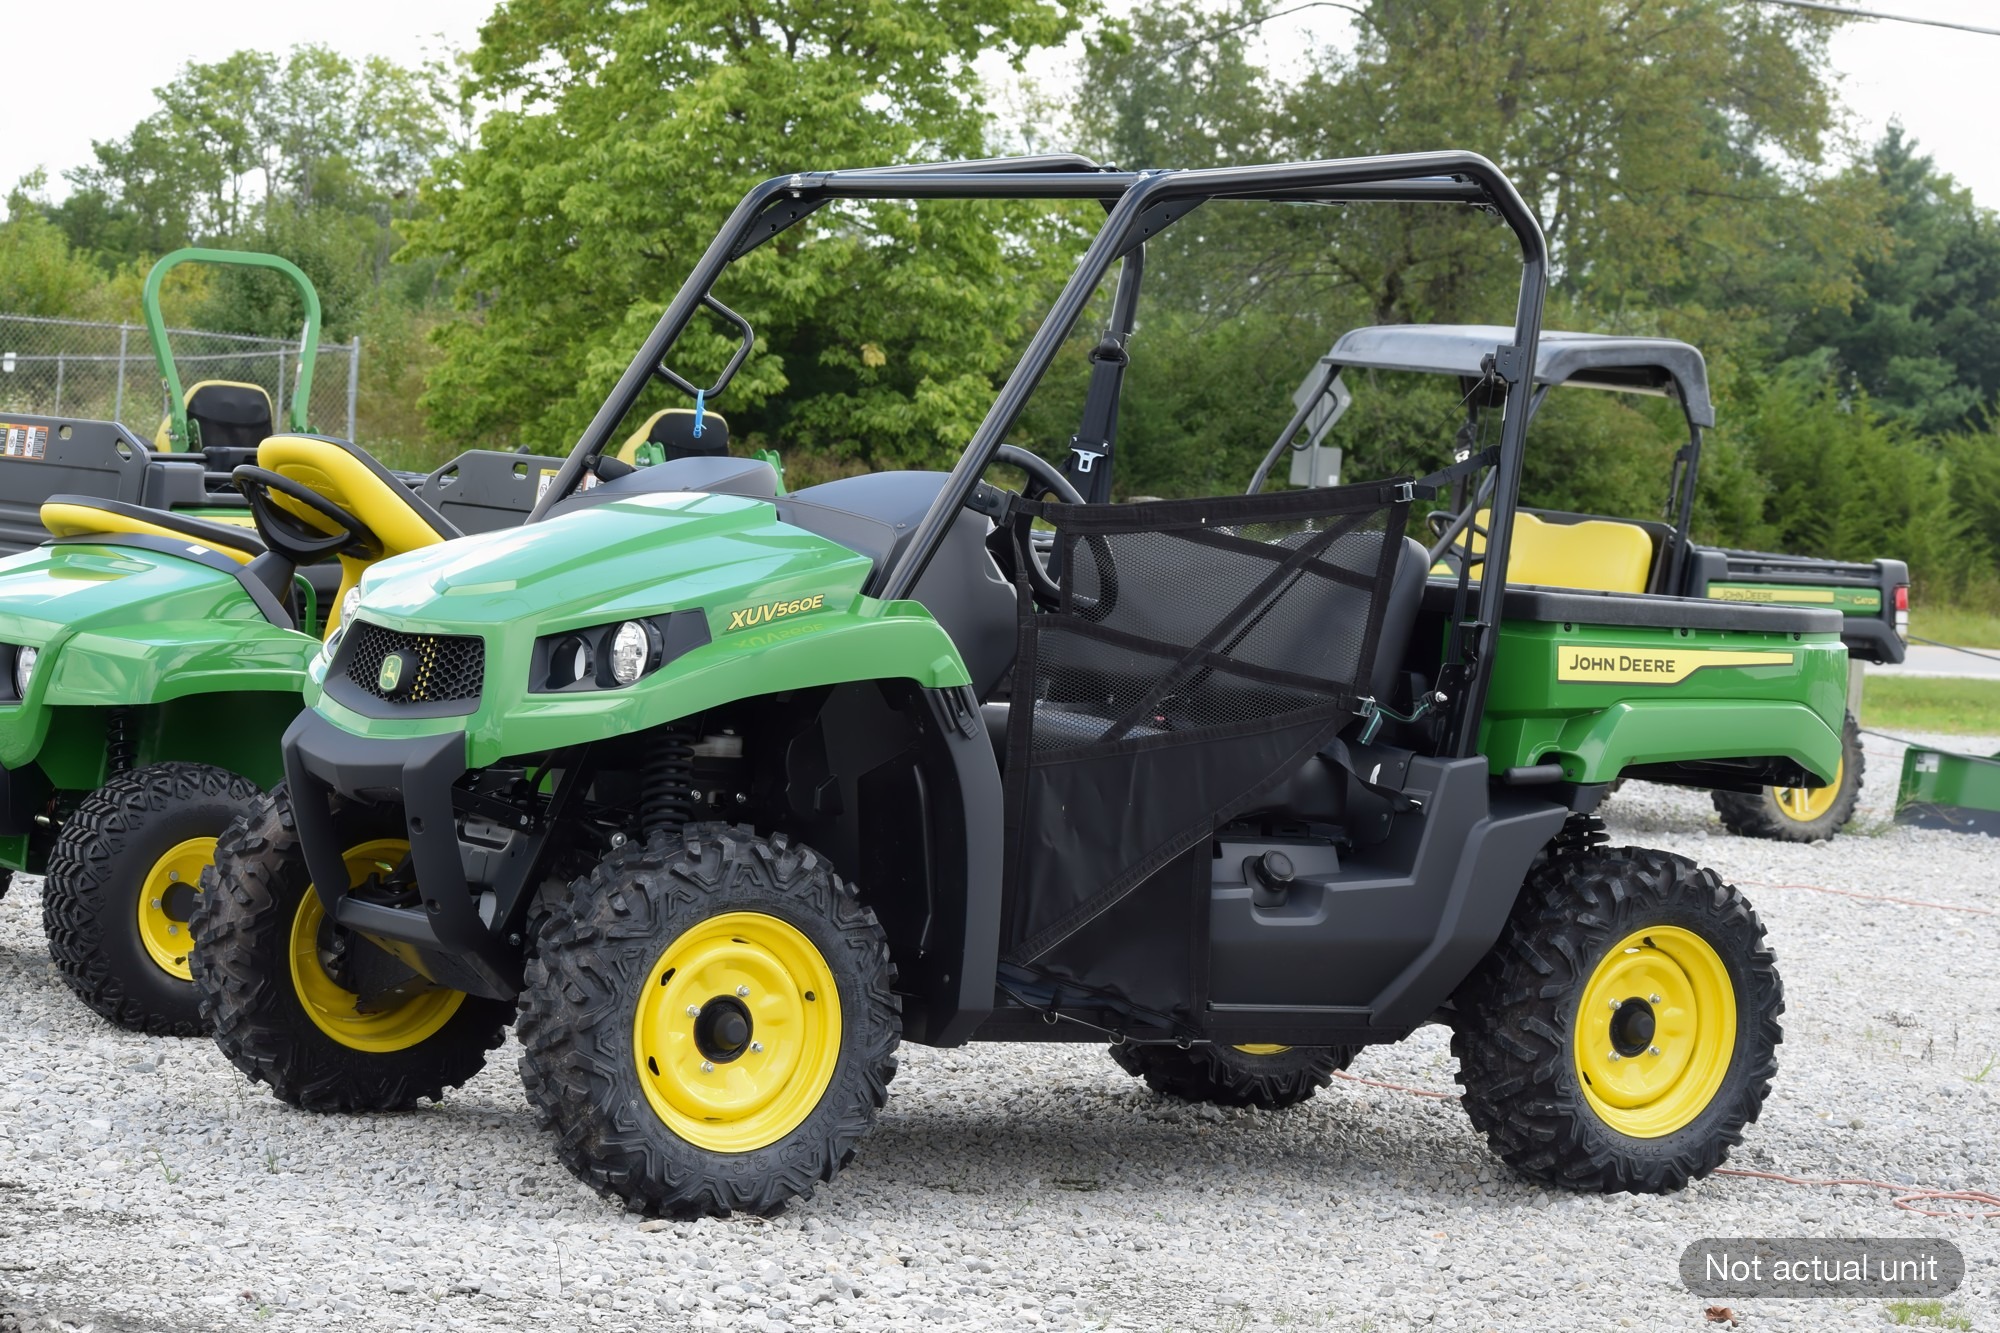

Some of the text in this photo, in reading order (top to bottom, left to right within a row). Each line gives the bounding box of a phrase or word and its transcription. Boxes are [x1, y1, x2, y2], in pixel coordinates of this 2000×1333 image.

[1720, 589, 1773, 601] JOHN DEERE
[727, 594, 825, 631] XUV560E
[1570, 654, 1675, 673] JOHN DEERE
